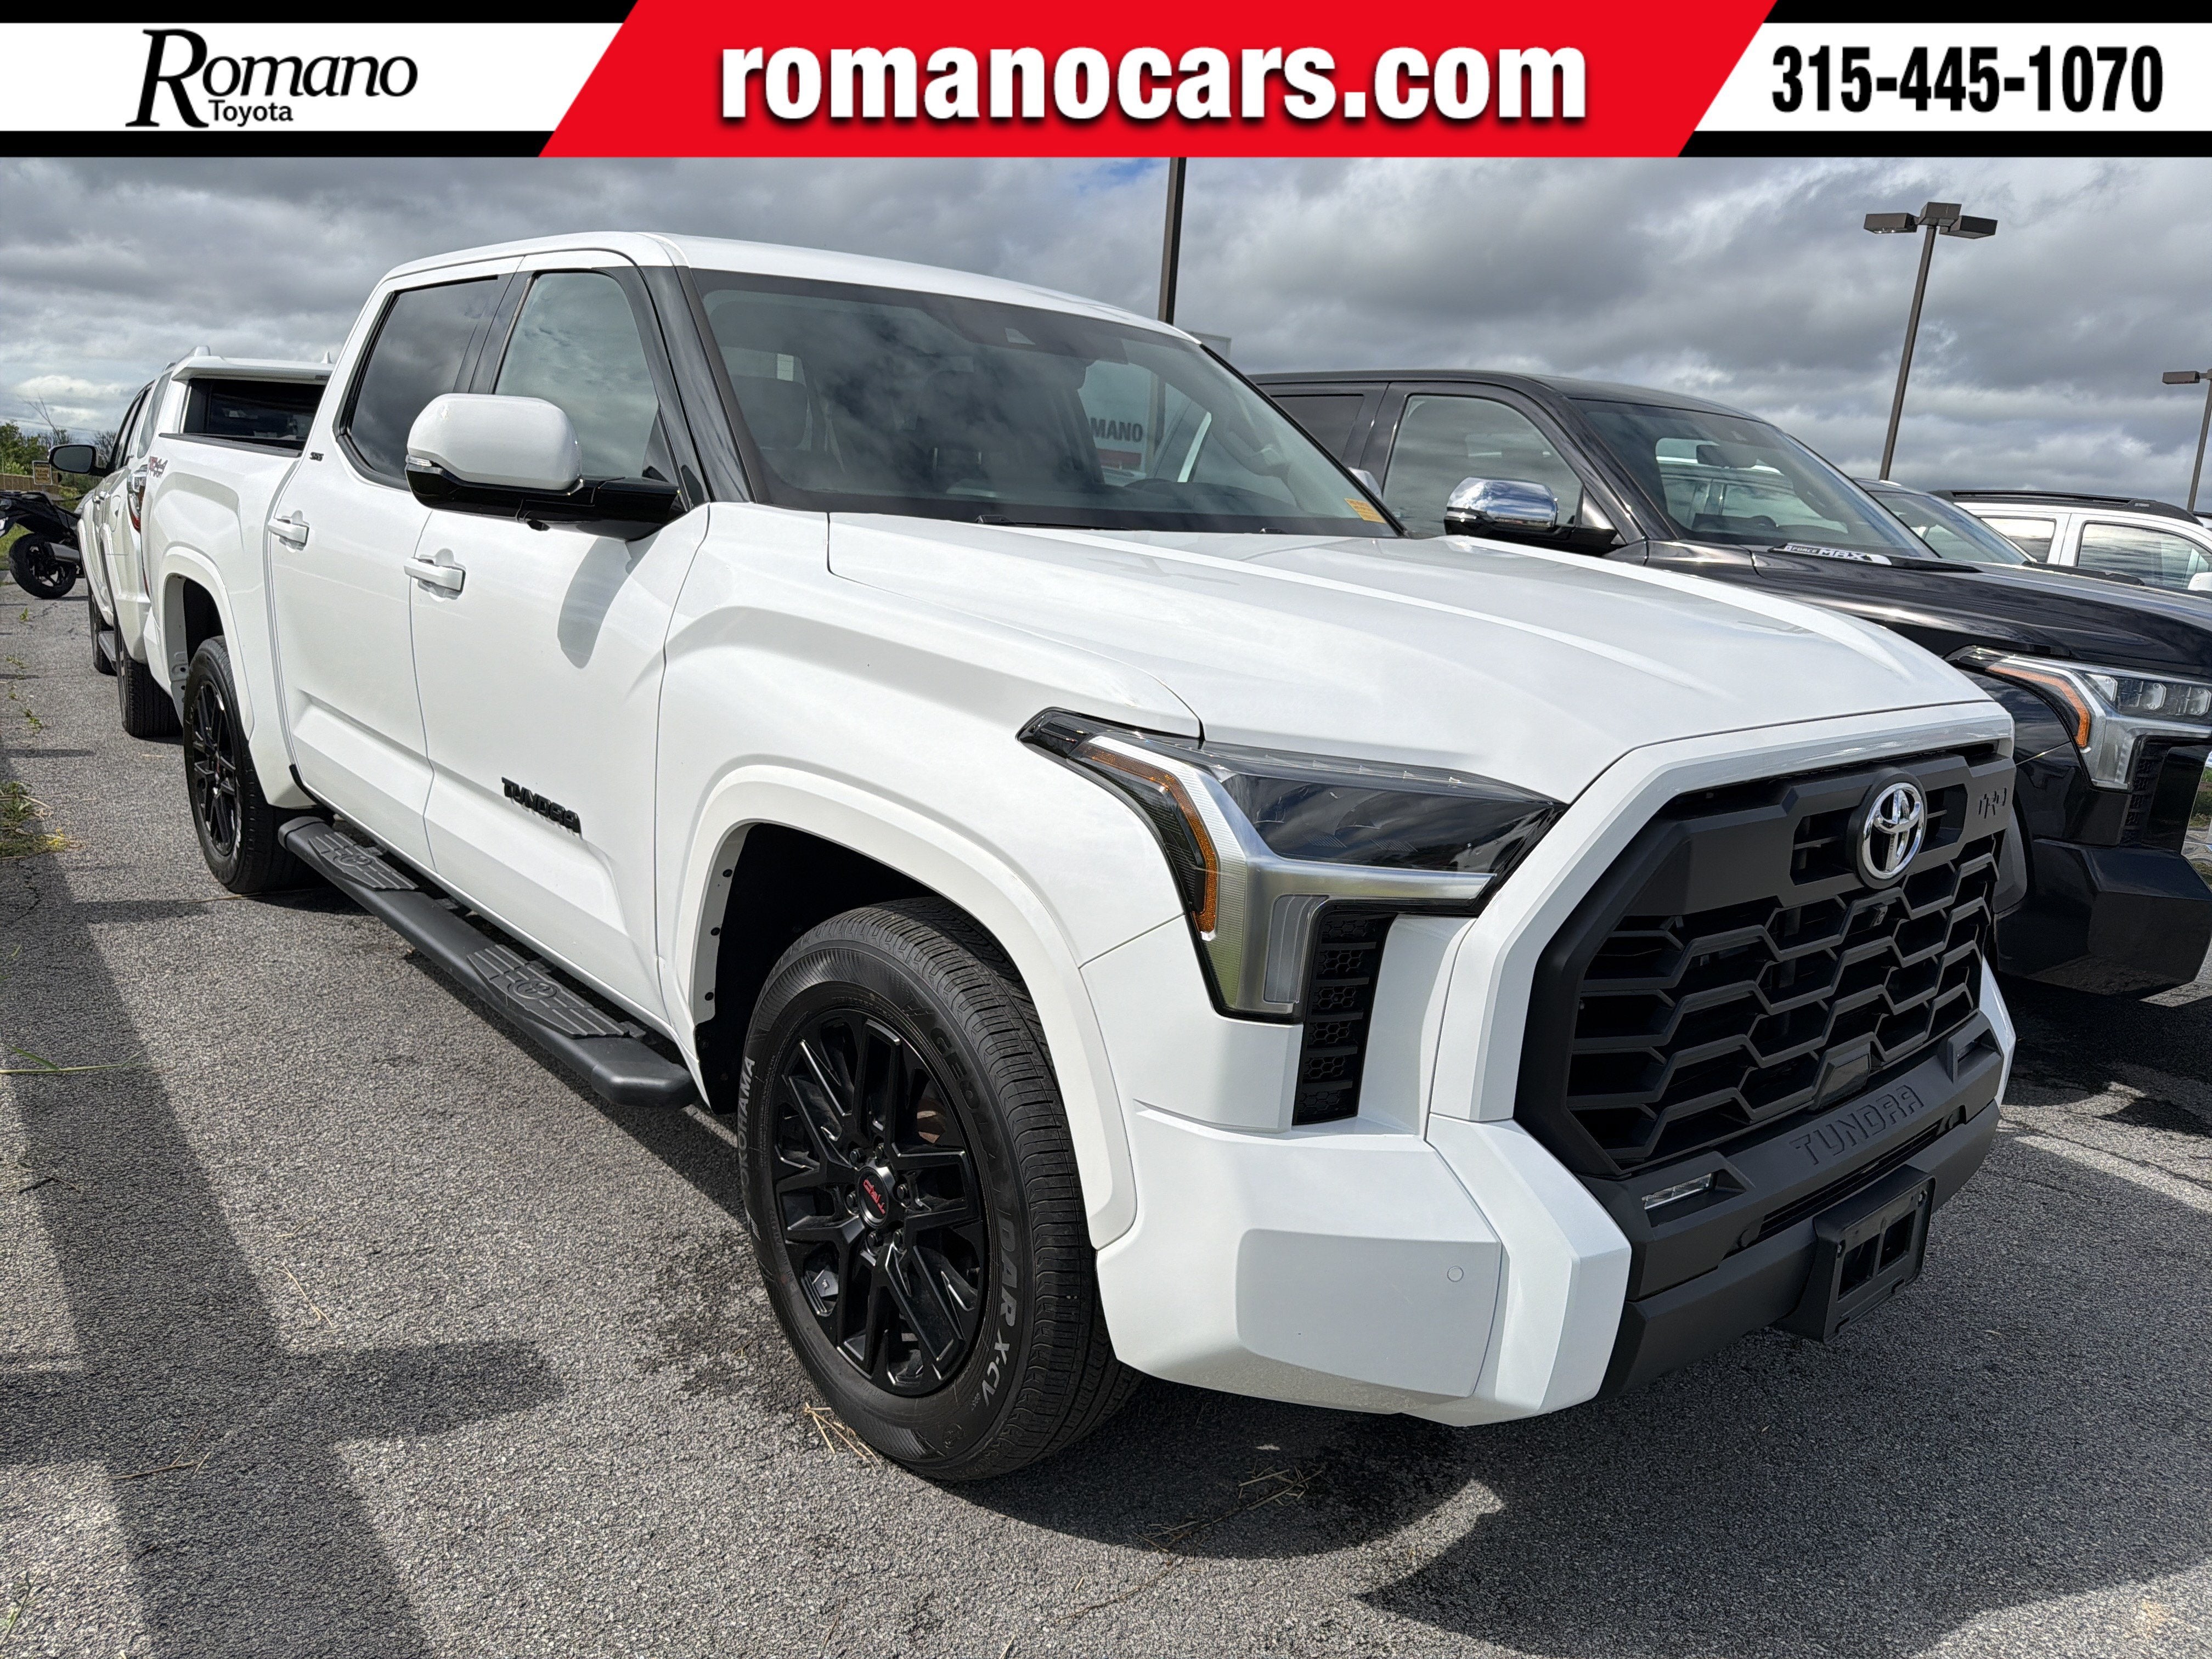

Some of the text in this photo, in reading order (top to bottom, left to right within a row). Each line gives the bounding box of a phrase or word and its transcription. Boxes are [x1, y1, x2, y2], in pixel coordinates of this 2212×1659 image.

[501, 776, 582, 834] TUNDRA
[738, 1056, 755, 1199] OKOHAMA
[1789, 1085, 1924, 1165] TUNDRA
